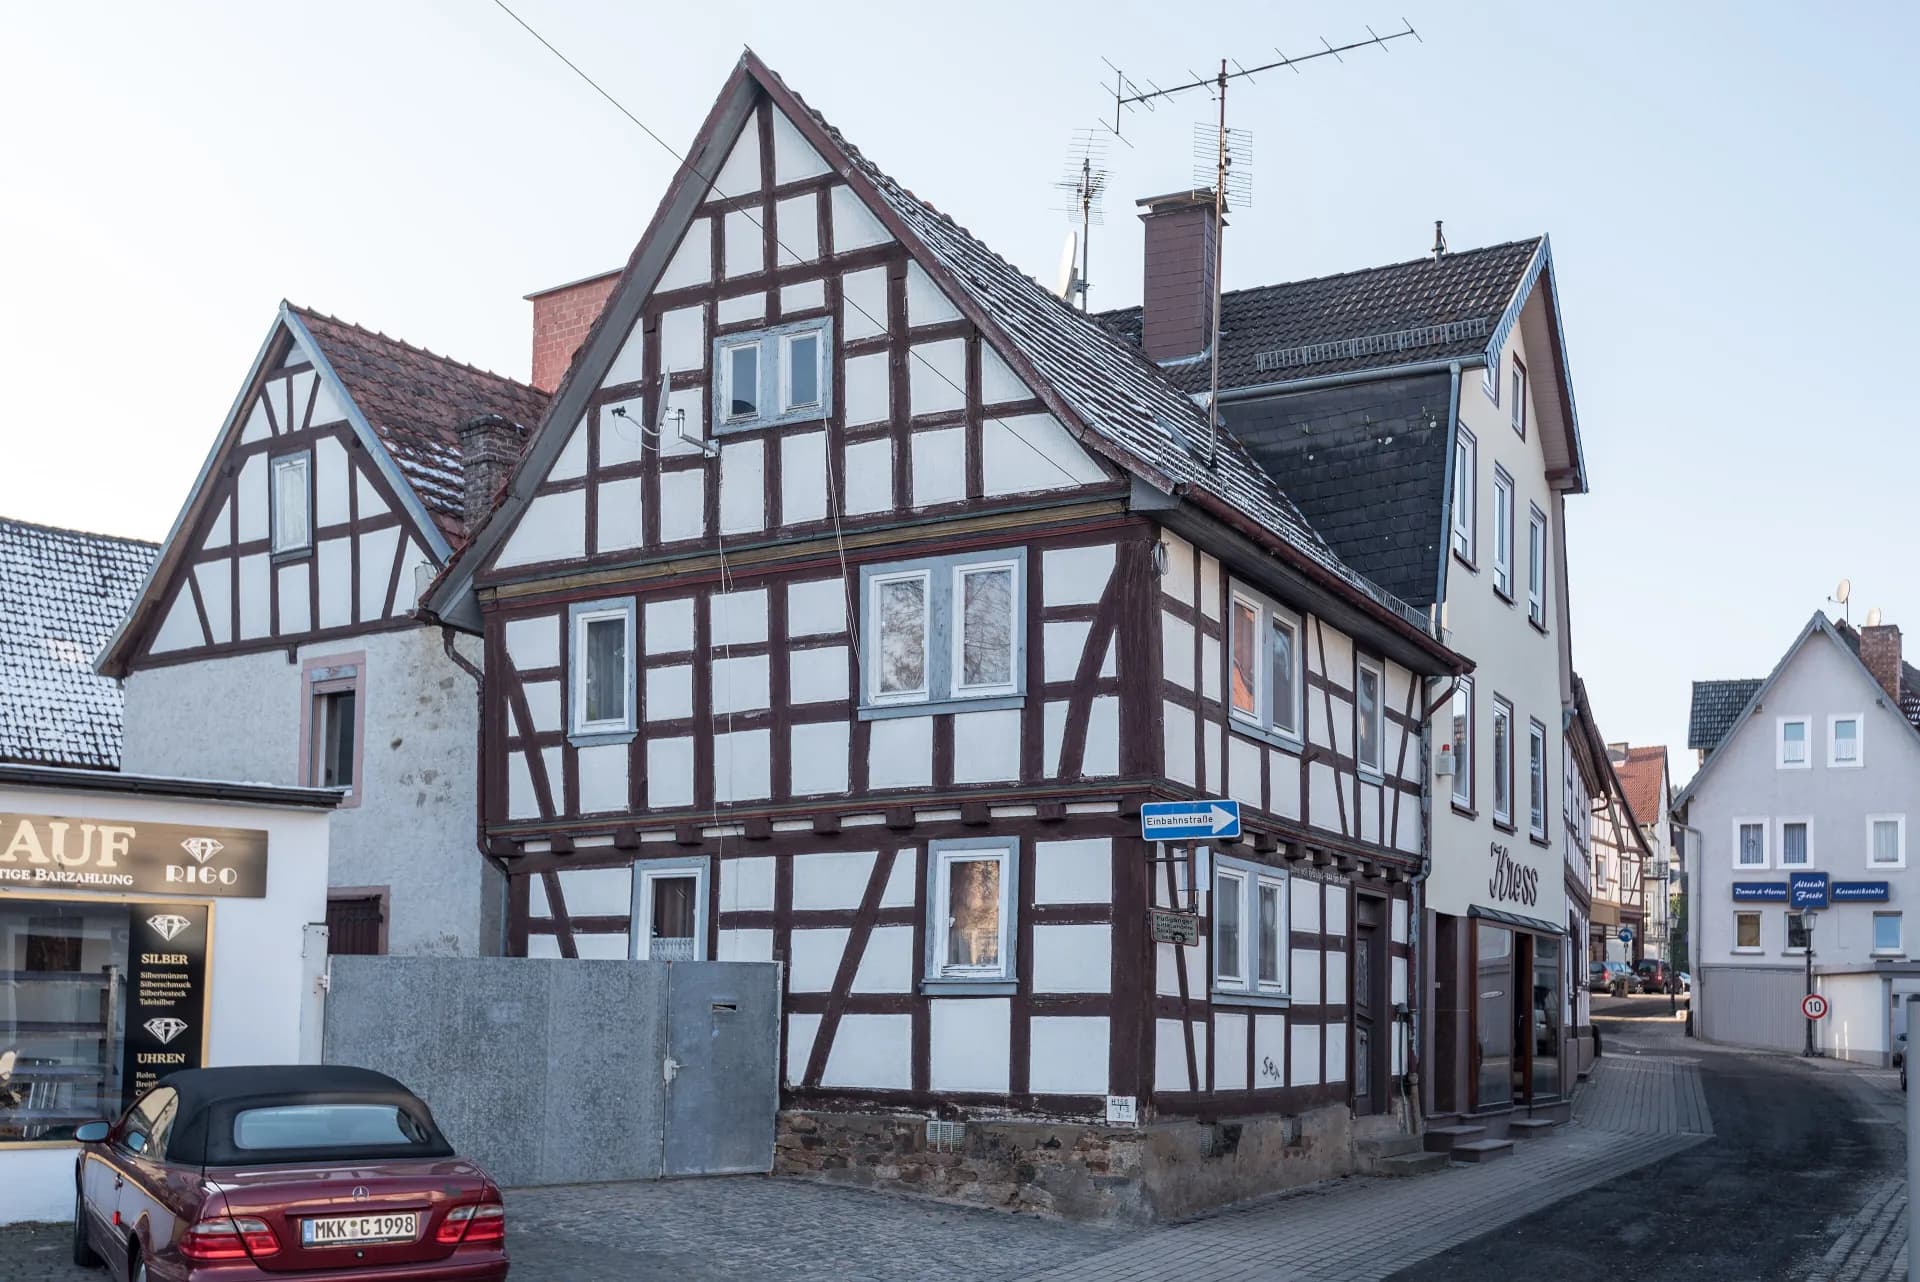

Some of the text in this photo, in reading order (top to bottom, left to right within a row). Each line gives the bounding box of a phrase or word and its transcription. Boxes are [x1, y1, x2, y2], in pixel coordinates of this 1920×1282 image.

[1146, 815, 1213, 826] Einbahnstraße
[0, 819, 136, 867] AUF
[35, 868, 134, 886] BARZAHLUNG
[166, 864, 238, 885] RIGO
[1489, 841, 1538, 907] Kress
[1793, 880, 1825, 889] Altstadt
[141, 953, 189, 965] SILBER
[140, 972, 189, 980] Silbermünzen
[140, 989, 187, 997] Silberbesteck
[1809, 1001, 1821, 1013] 10
[137, 1053, 186, 1064] UHREN
[136, 1071, 157, 1079] Rolex
[315, 1216, 414, 1239] MKK C 1998
